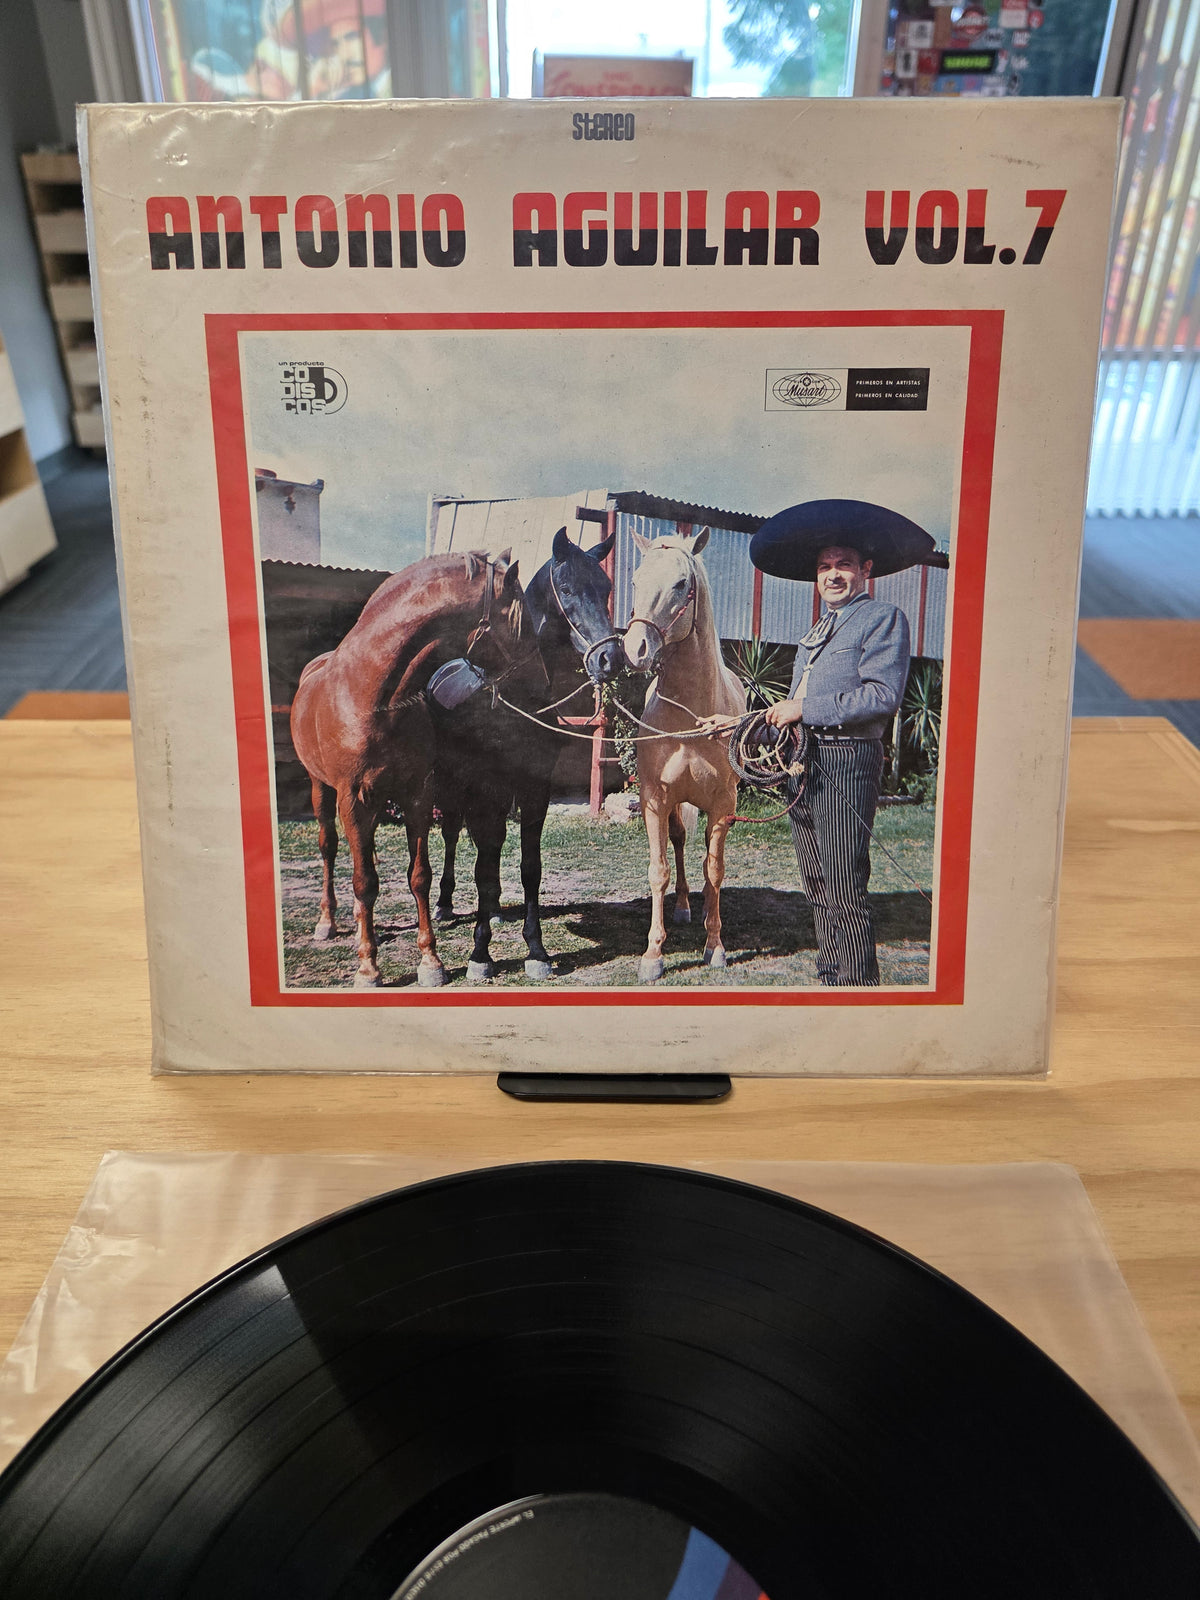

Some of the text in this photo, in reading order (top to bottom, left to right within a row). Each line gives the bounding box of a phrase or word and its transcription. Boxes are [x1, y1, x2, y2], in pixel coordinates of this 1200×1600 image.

[146, 192, 467, 271] ANTONIO
[512, 190, 820, 268] AGUILAR
[784, 384, 826, 397] Musart
